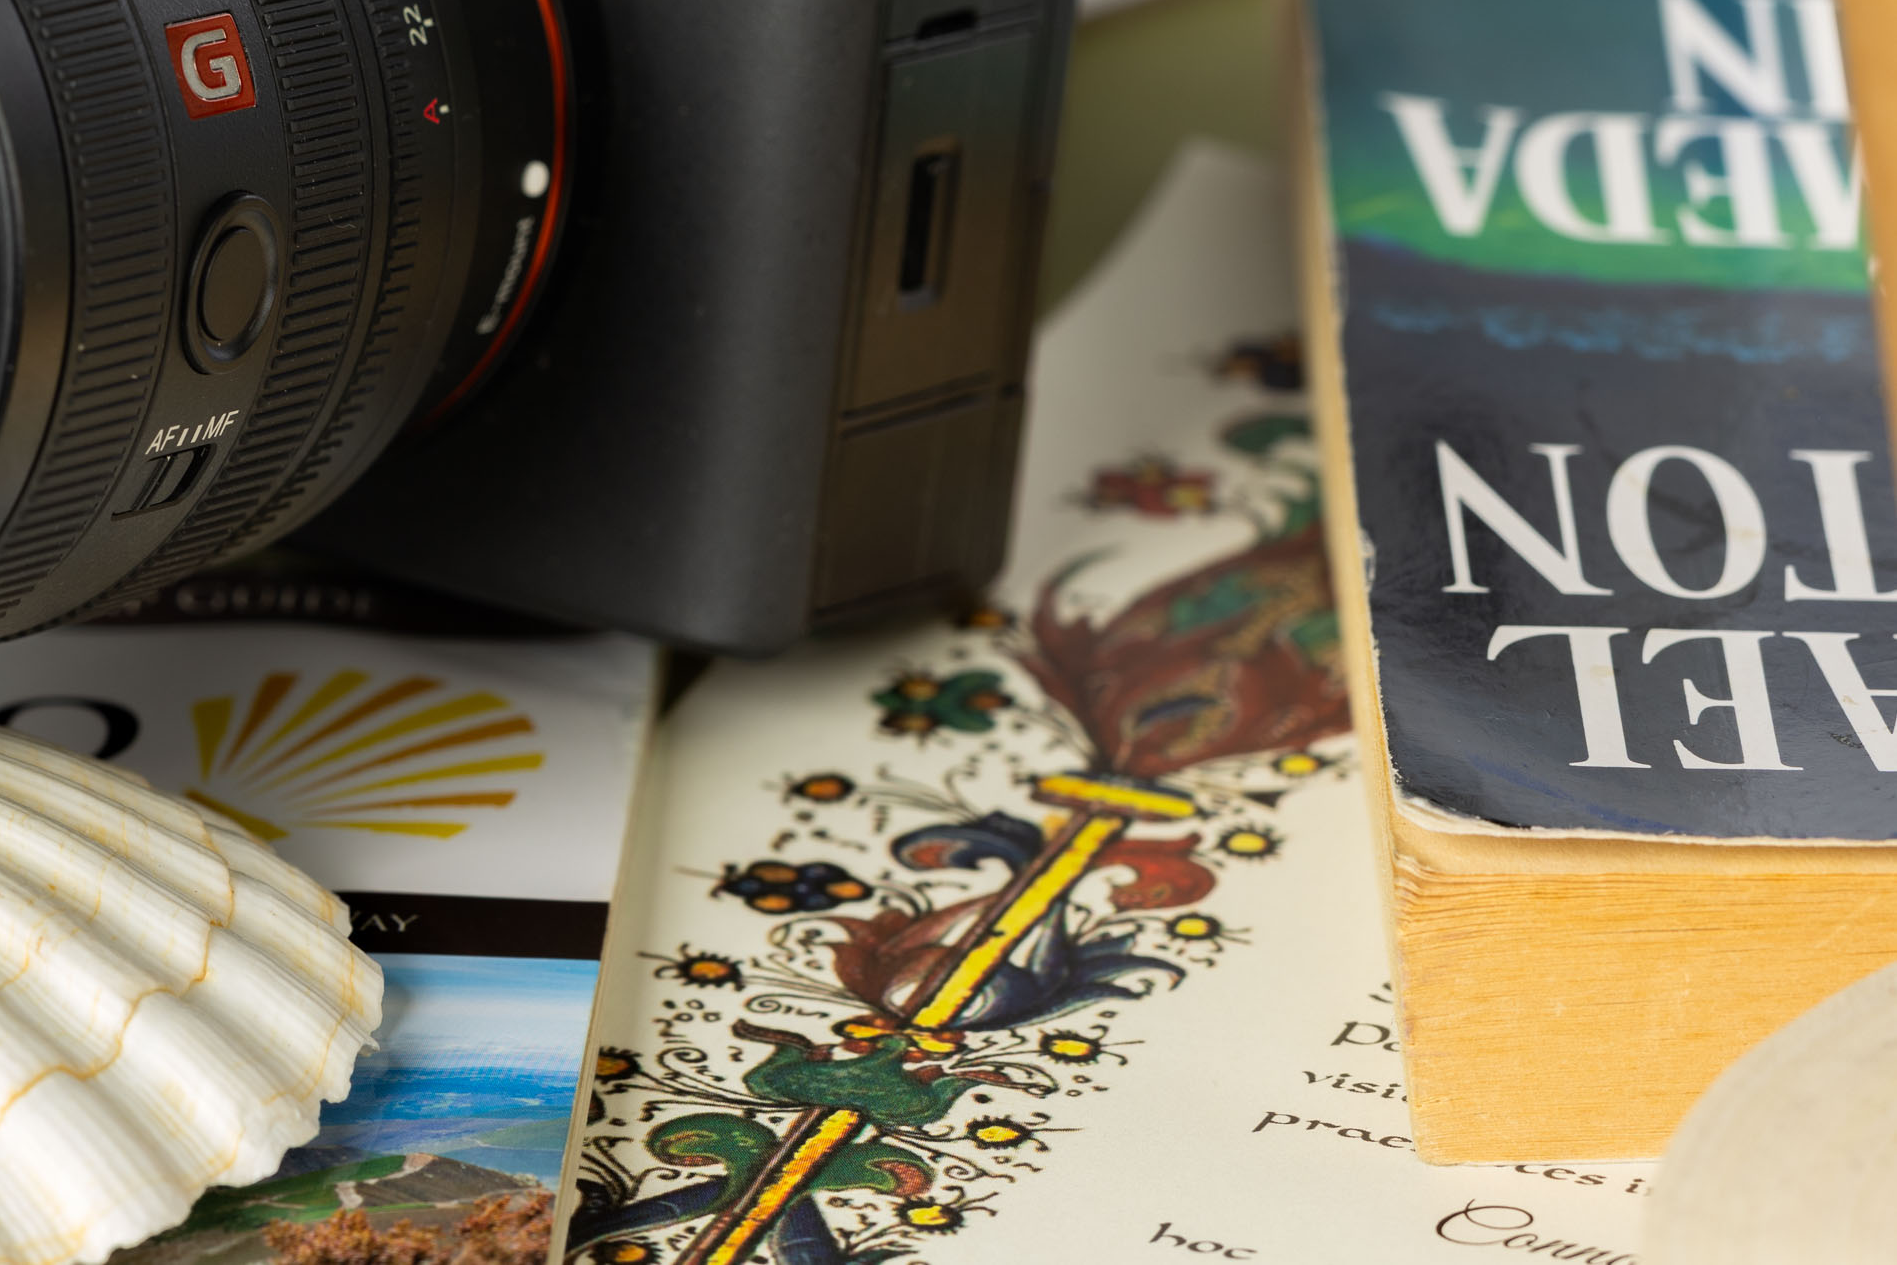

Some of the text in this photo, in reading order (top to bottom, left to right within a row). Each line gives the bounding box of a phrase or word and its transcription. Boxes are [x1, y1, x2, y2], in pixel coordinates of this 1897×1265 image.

[403, 3, 429, 46] 22
[181, 28, 243, 103] G
[145, 409, 240, 455] AF MF
[1435, 439, 1897, 602] TON
[351, 911, 420, 932] AY
[1302, 1070, 1408, 1104] visi
[1252, 1110, 1415, 1153] prae
[1148, 1222, 1260, 1261] hoc
